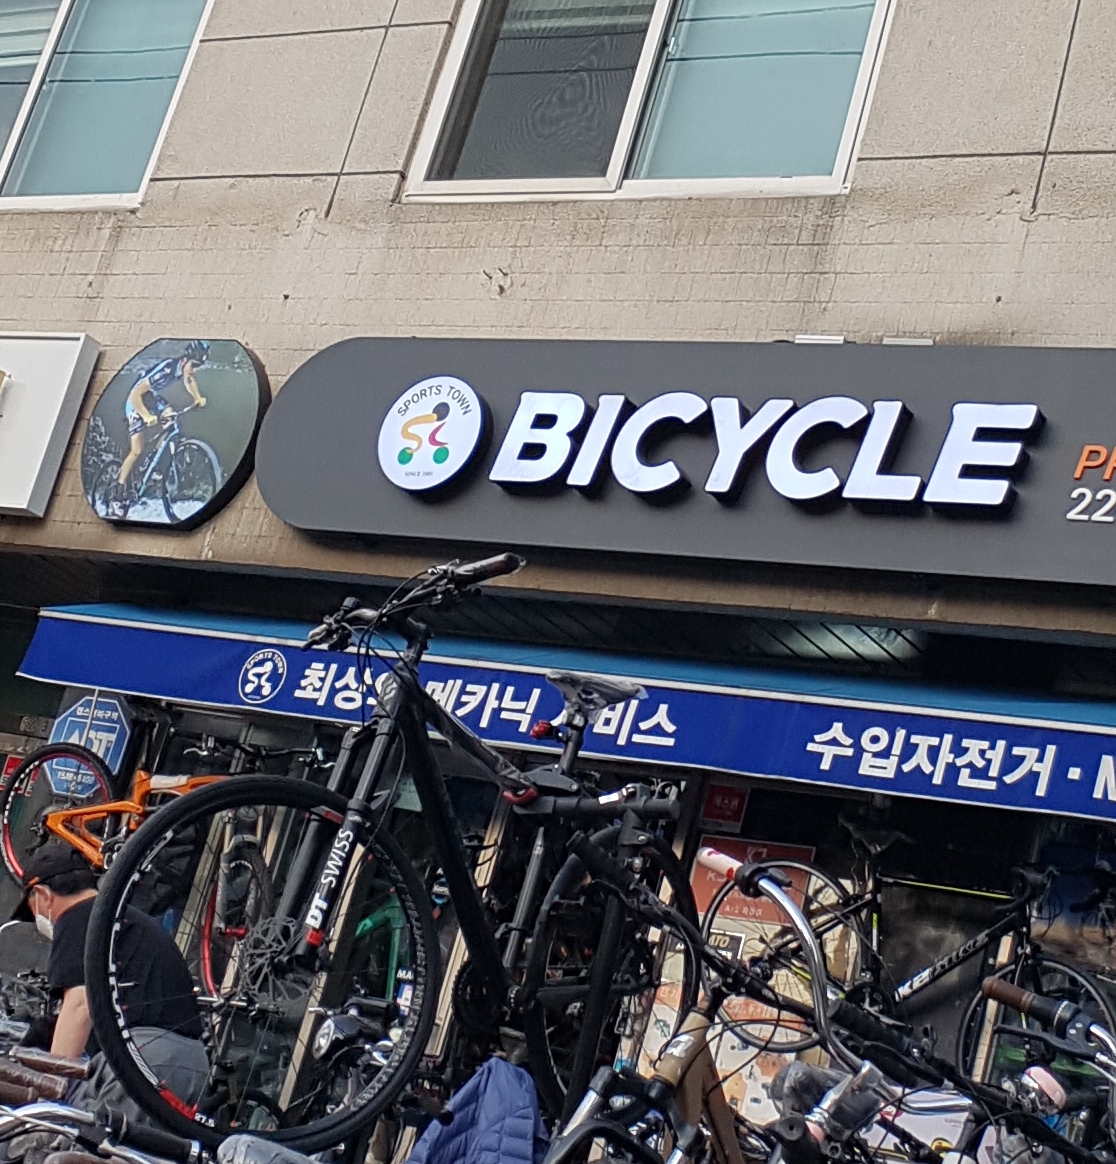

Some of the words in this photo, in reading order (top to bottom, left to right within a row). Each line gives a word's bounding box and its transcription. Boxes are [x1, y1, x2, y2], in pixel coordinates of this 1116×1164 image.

[397, 384, 443, 417] SPORTS
[446, 385, 473, 416] TOWN
[488, 391, 1040, 506] BICYCLE
[425, 678, 542, 734] 메카닉
[305, 892, 328, 929] DT
[320, 828, 354, 888] SWISS
